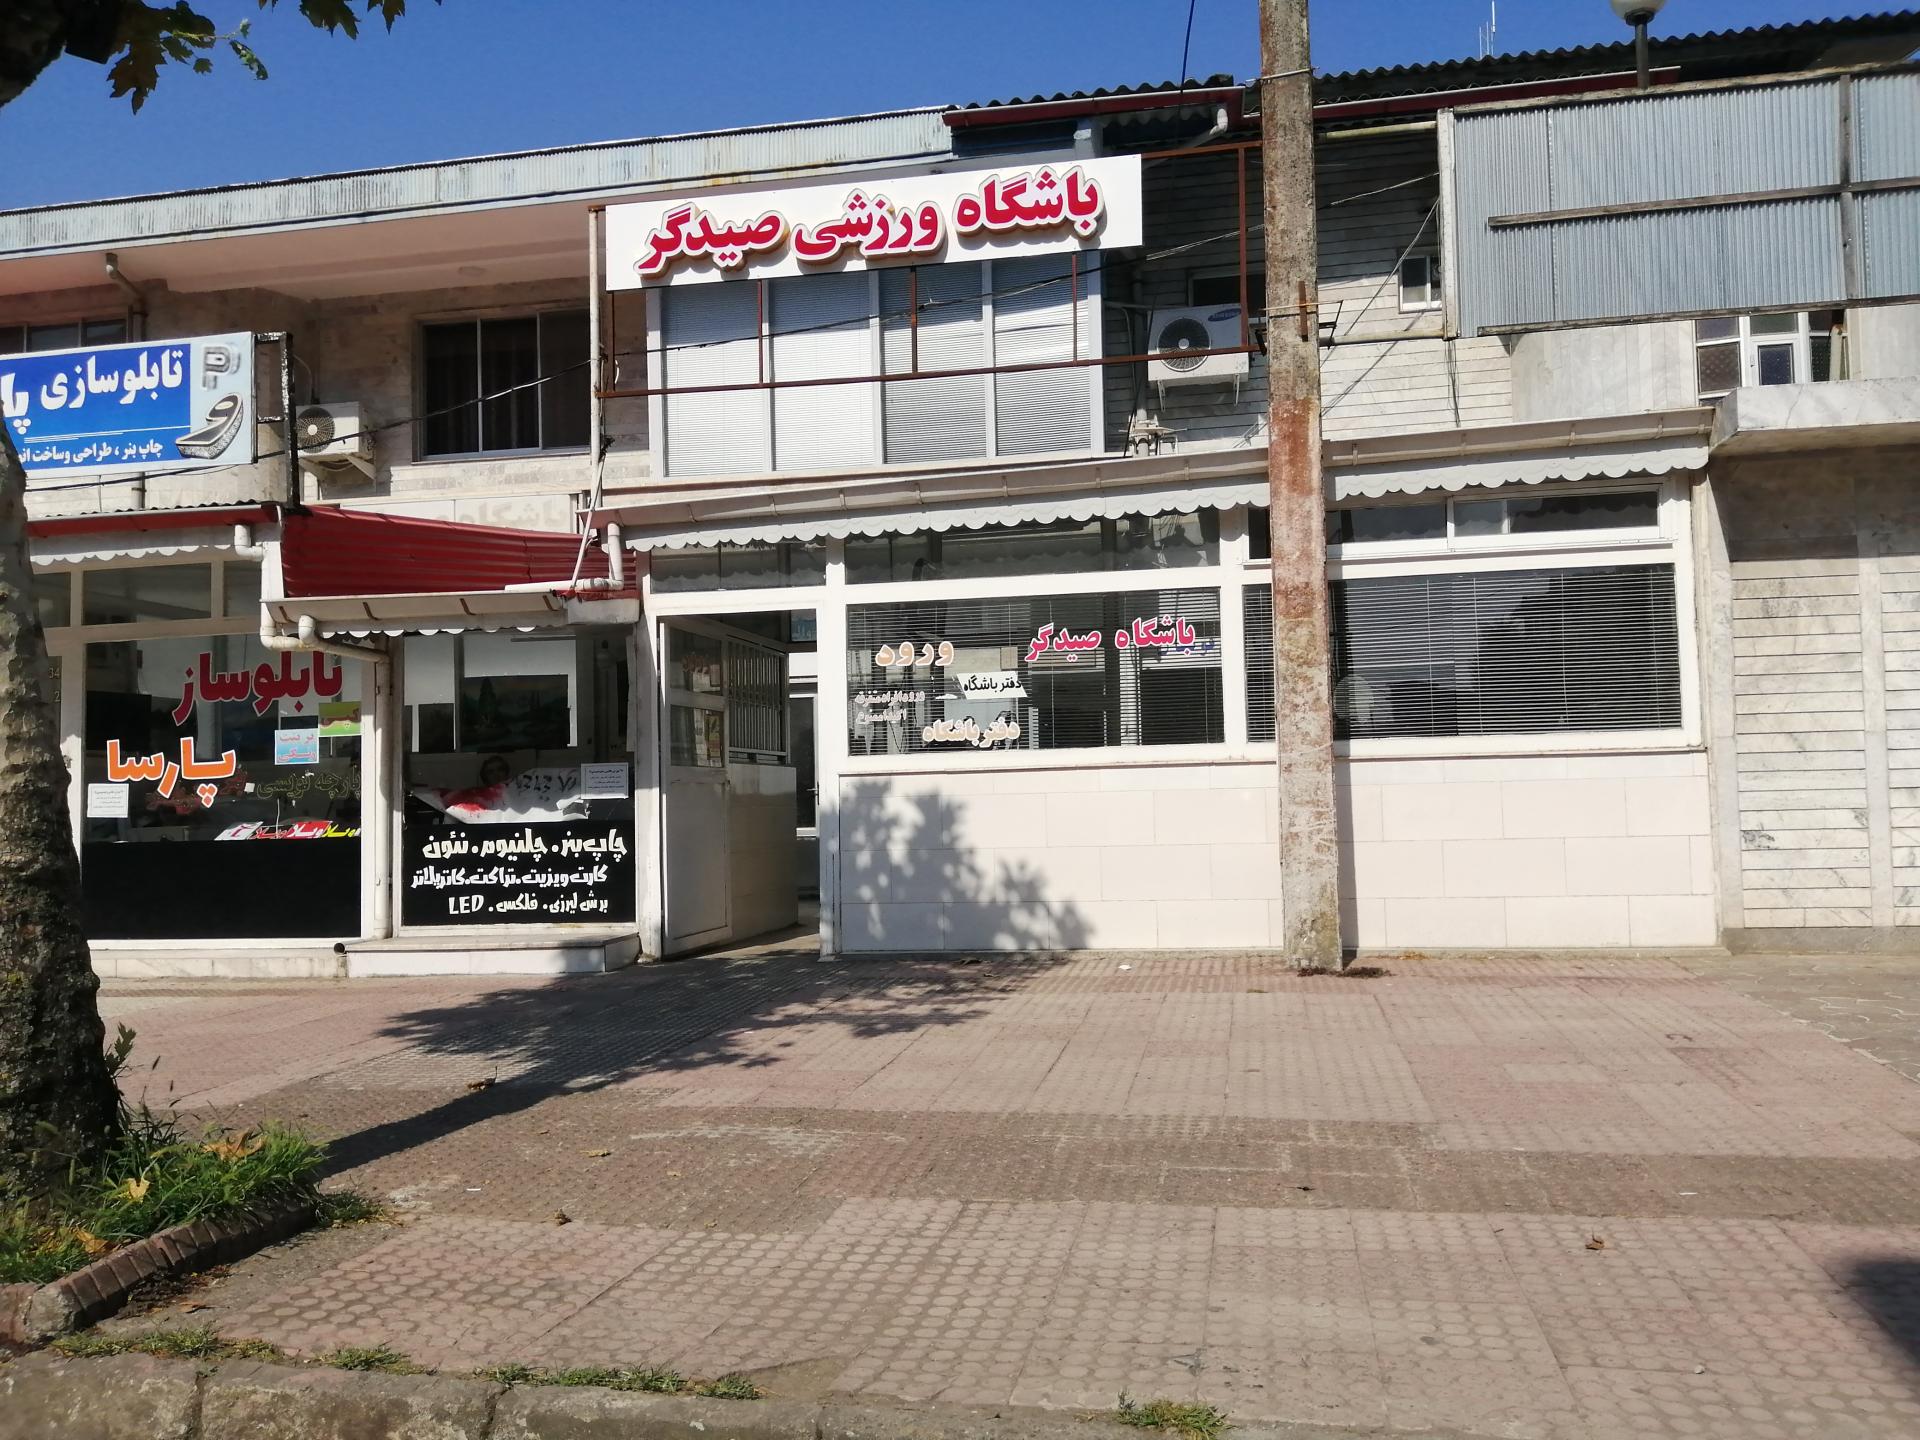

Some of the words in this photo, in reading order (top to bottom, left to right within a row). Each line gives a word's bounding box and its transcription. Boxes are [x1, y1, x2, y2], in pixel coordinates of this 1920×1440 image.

[959, 167, 1098, 232] باشگاه
[793, 188, 940, 255] ورزشی
[636, 205, 783, 273] صیدگر
[72, 442, 113, 464] طراحی
[138, 438, 163, 459] چاپ
[1024, 622, 1102, 662] صیدگر
[1114, 614, 1196, 656] باشگاه
[875, 641, 955, 666] ورود
[963, 675, 999, 693] باشگاه
[999, 676, 1022, 693] دفتر
[922, 718, 981, 747] باشگاه
[979, 716, 1021, 748] دفتر
[106, 735, 237, 809] پارسا
[422, 831, 469, 859] نئون
[480, 827, 549, 862] چلنیوم
[560, 830, 583, 858] بنر
[583, 828, 628, 862] چاپ
[470, 866, 516, 888] تراکت
[521, 867, 570, 888] ویزیت
[569, 864, 609, 887] کارت
[448, 894, 485, 915] LED
[495, 892, 539, 913] فلکس
